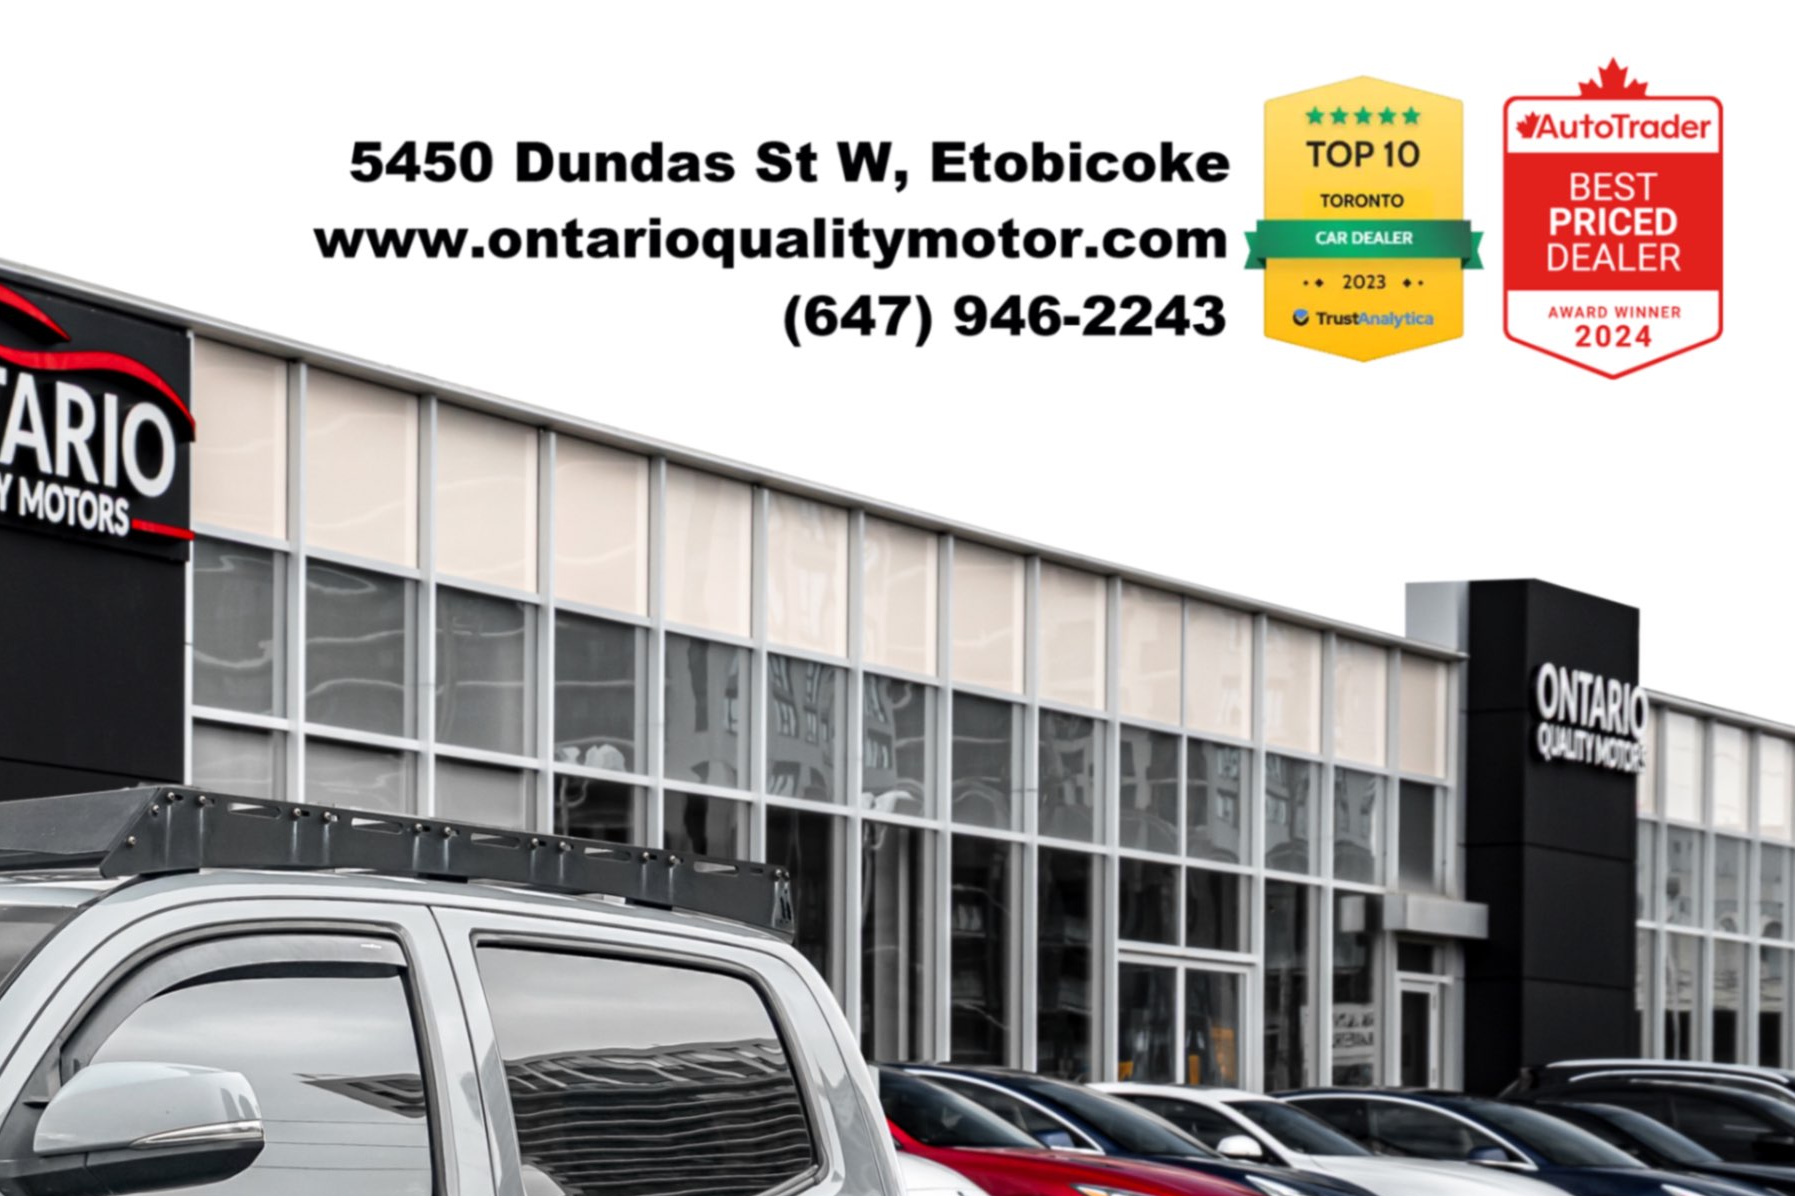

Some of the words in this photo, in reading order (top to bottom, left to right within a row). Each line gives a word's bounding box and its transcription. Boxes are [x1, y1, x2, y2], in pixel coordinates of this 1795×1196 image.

[18, 476, 131, 537] MOTORS
[1536, 662, 1649, 740] ONTARIO
[1537, 722, 1595, 763] QUALITY
[1594, 733, 1647, 774] MOTORS
